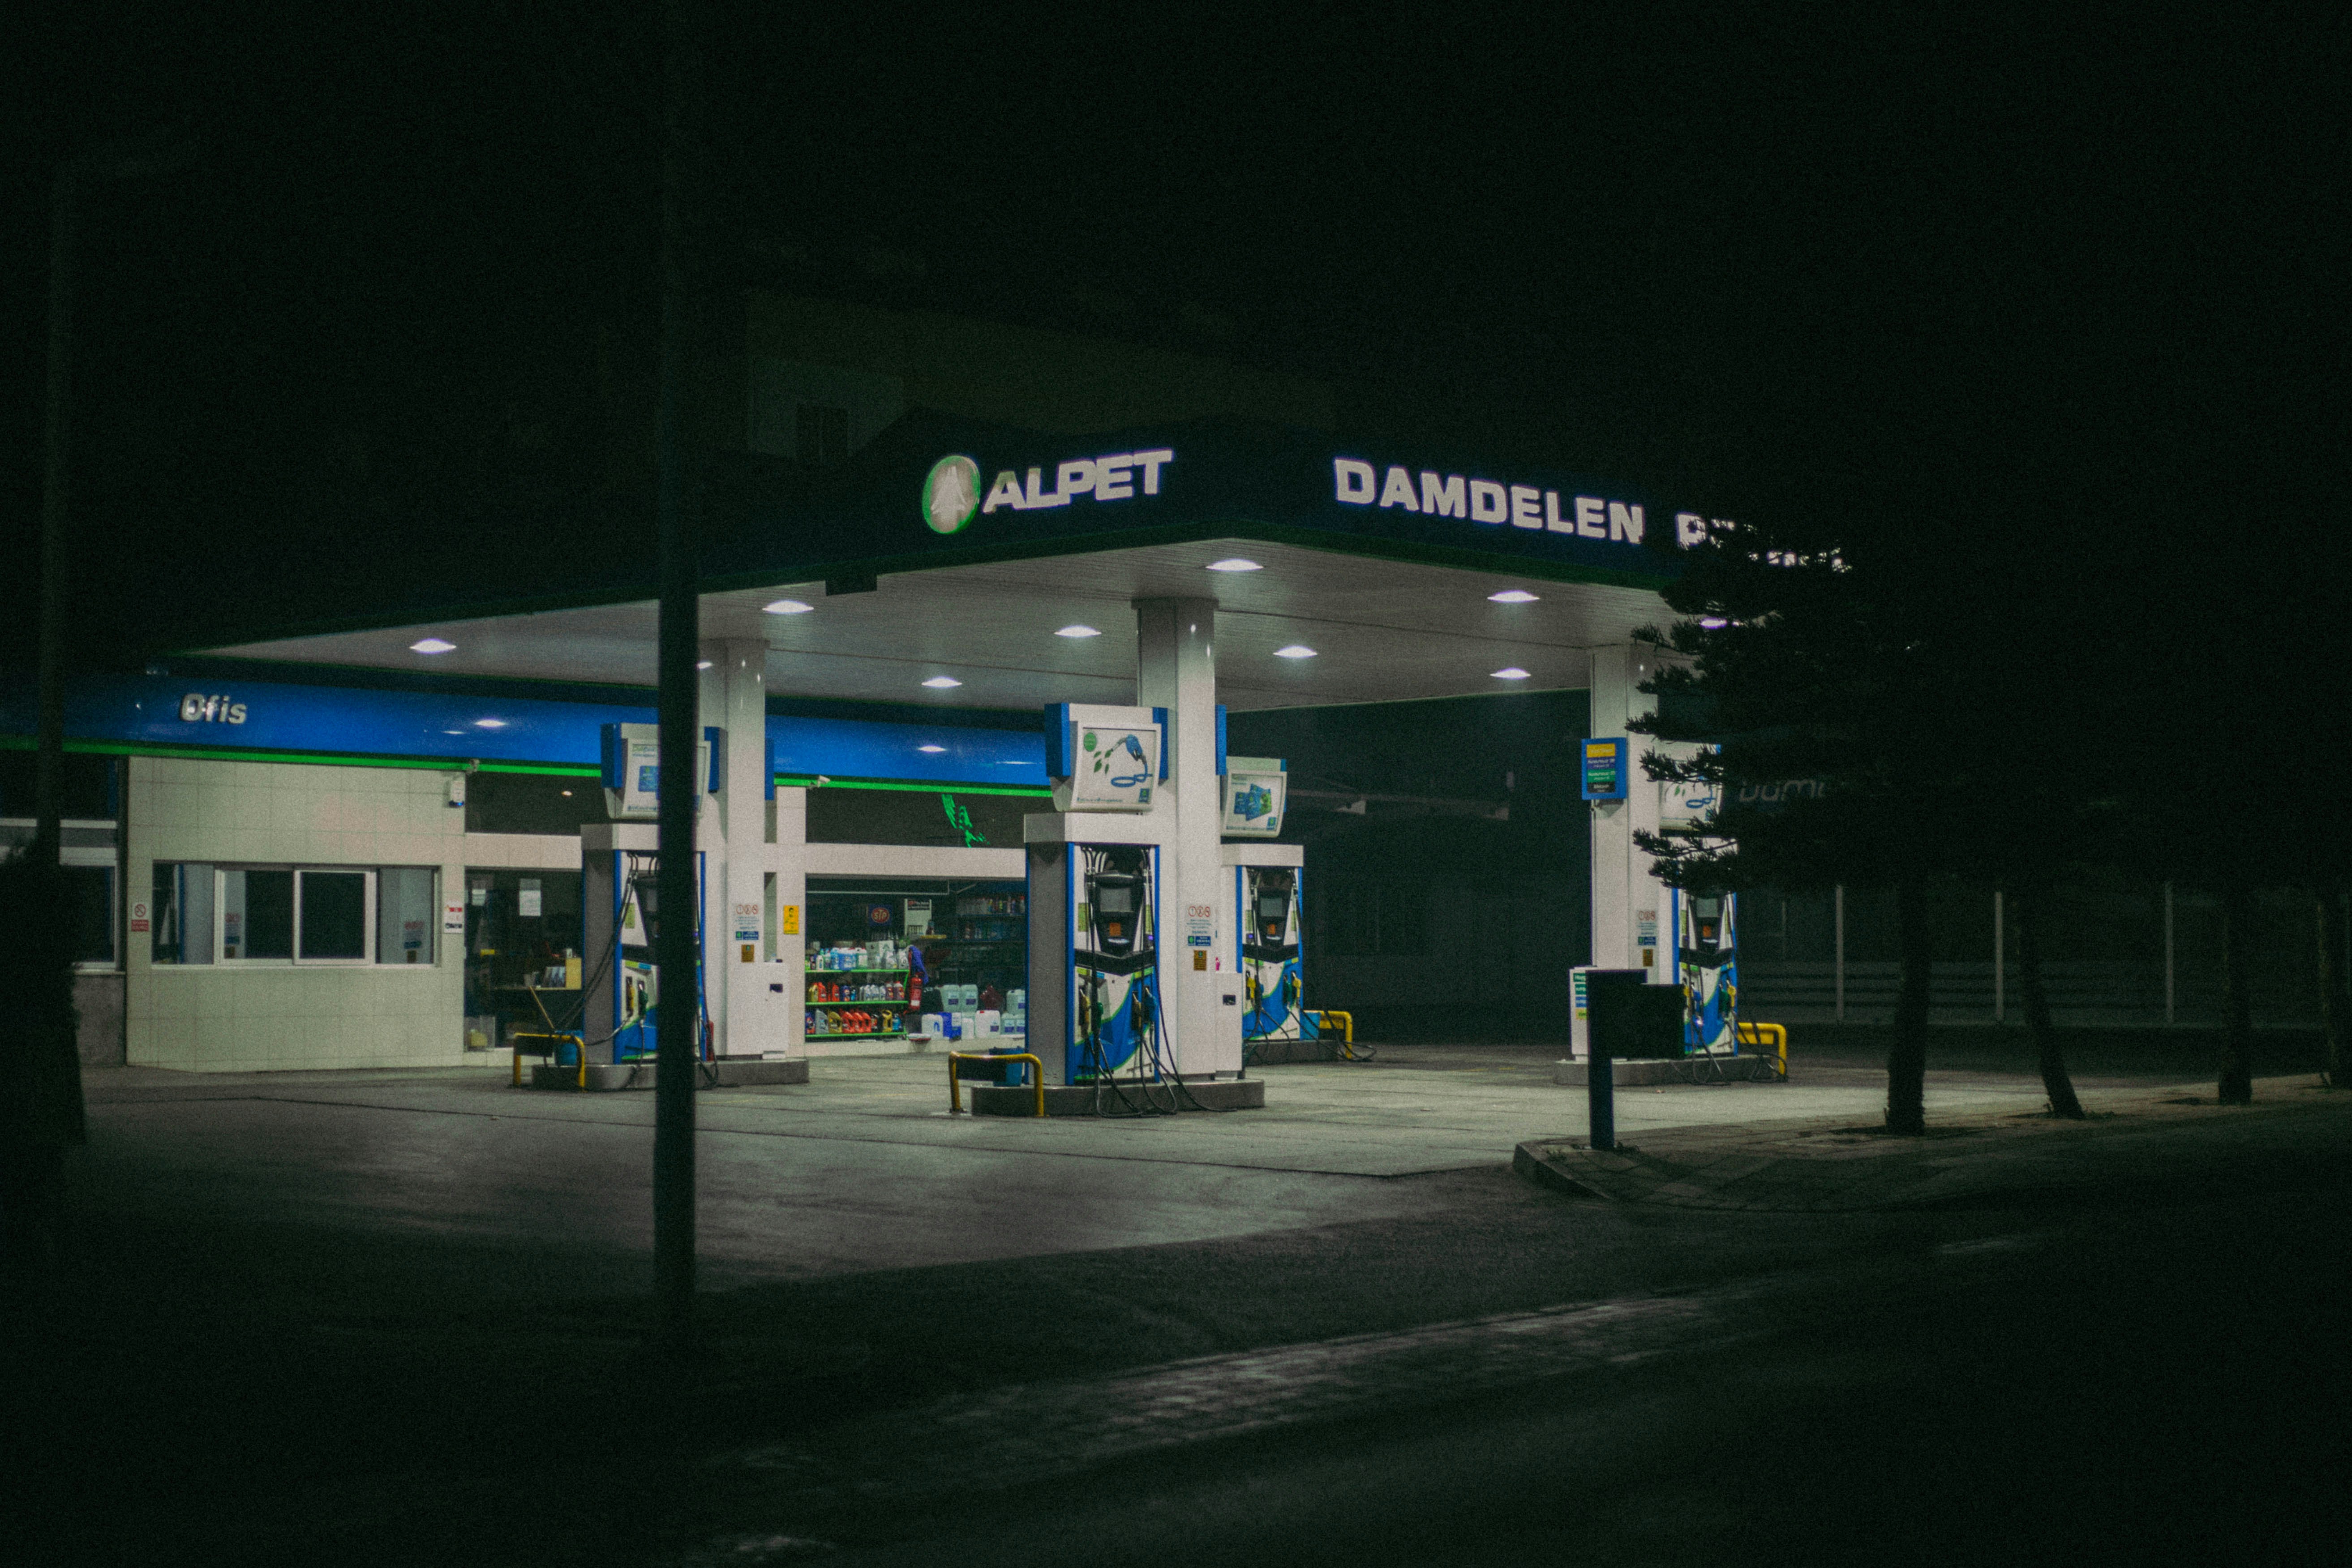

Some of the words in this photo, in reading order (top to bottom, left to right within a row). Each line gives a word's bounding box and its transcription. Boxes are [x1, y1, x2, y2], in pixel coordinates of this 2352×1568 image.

[983, 450, 1173, 513] ALPET
[1334, 458, 1644, 545] DAMDELEN
[181, 693, 247, 724] Ofis
[874, 909, 887, 920] STP
